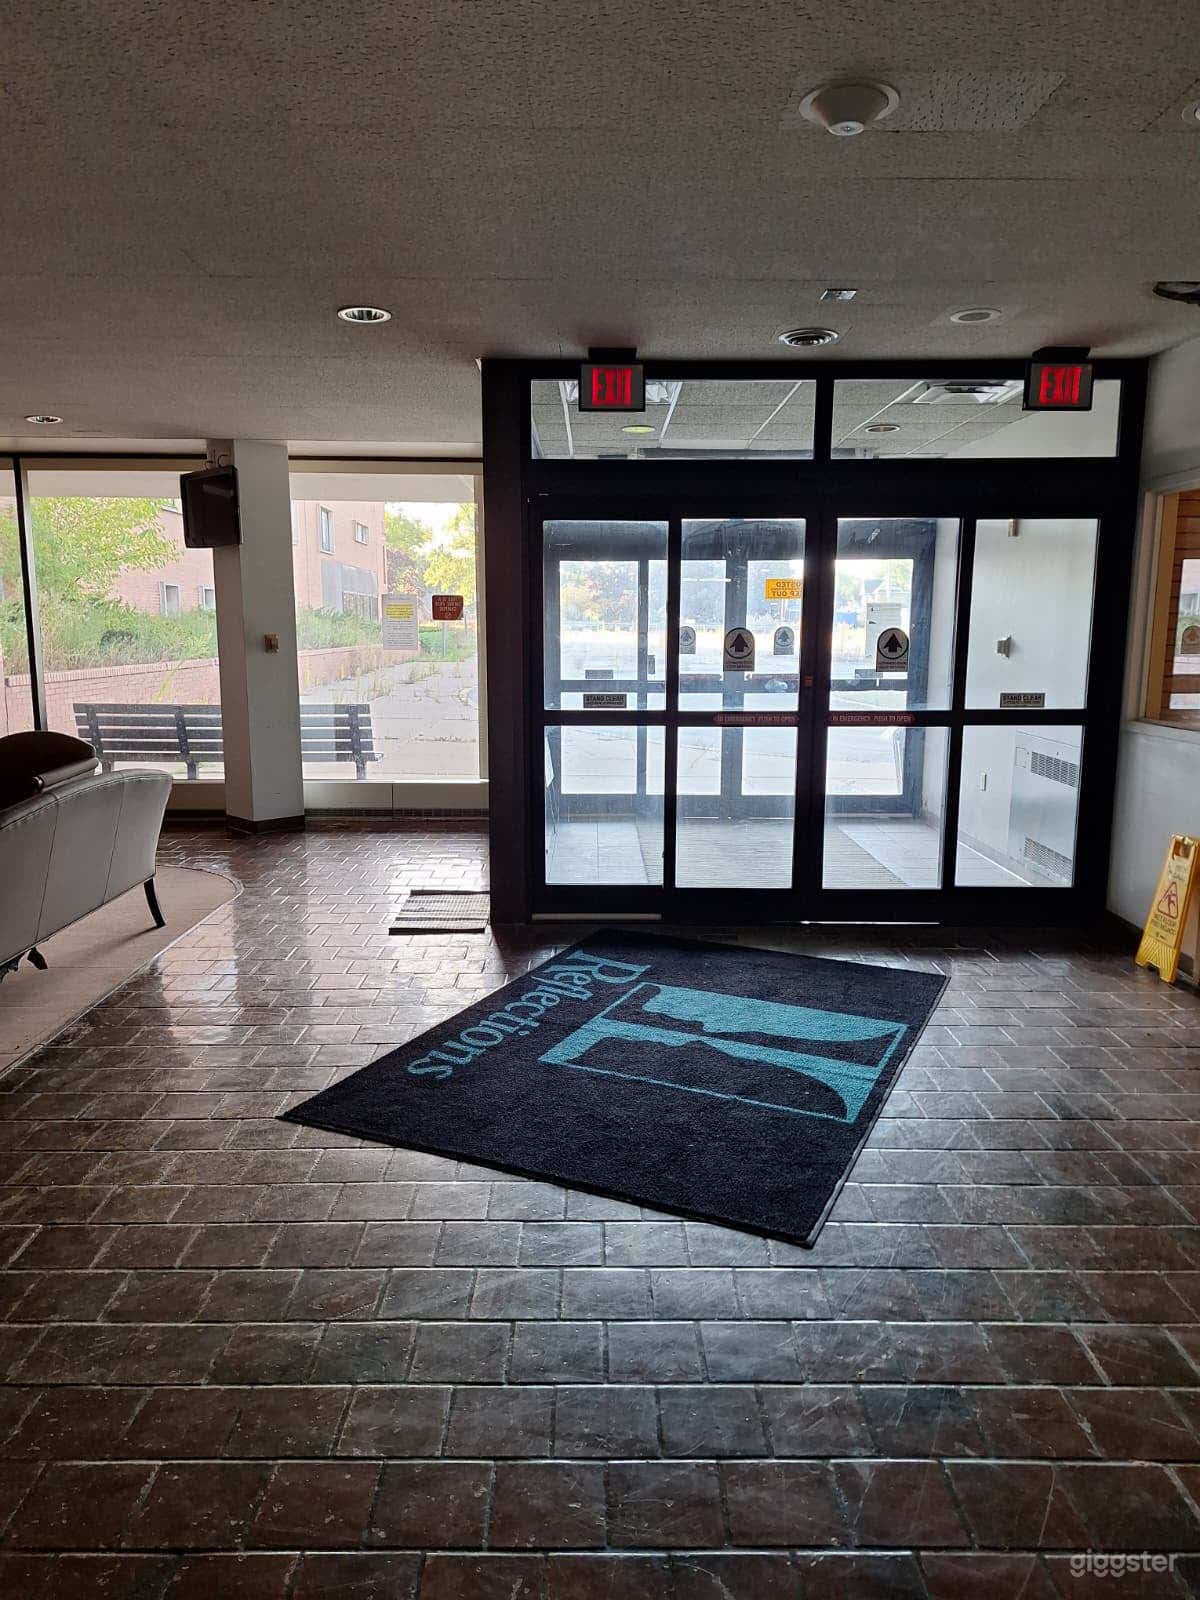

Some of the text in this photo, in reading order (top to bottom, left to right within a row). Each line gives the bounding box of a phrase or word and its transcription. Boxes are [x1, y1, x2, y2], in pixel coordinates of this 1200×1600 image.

[591, 367, 632, 407] EXIT
[1039, 366, 1082, 405] EXIT
[407, 950, 651, 1080] Reflections
